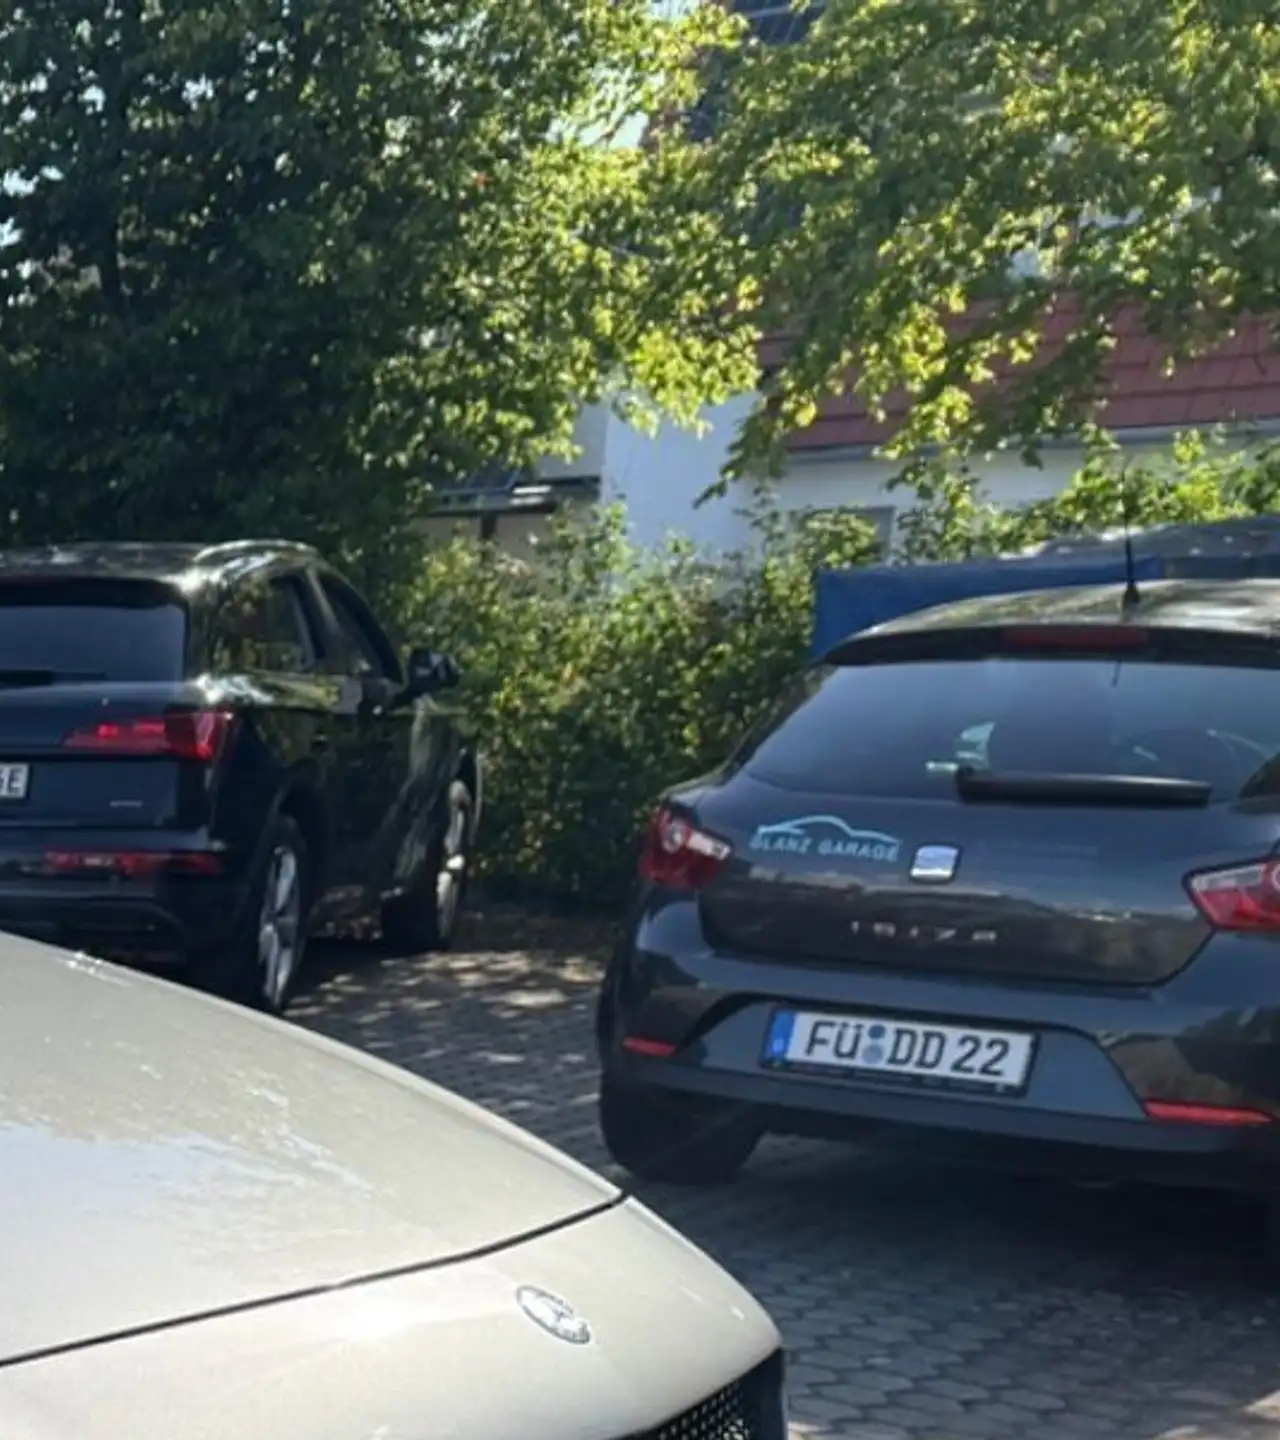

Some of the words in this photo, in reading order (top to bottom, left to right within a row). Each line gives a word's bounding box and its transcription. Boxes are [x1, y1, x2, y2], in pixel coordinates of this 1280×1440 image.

[749, 835, 812, 855] GLANZ
[816, 838, 901, 863] GARAGE
[806, 1019, 865, 1061] FÜ
[886, 1026, 948, 1070] DD
[950, 1033, 1012, 1077] 22
